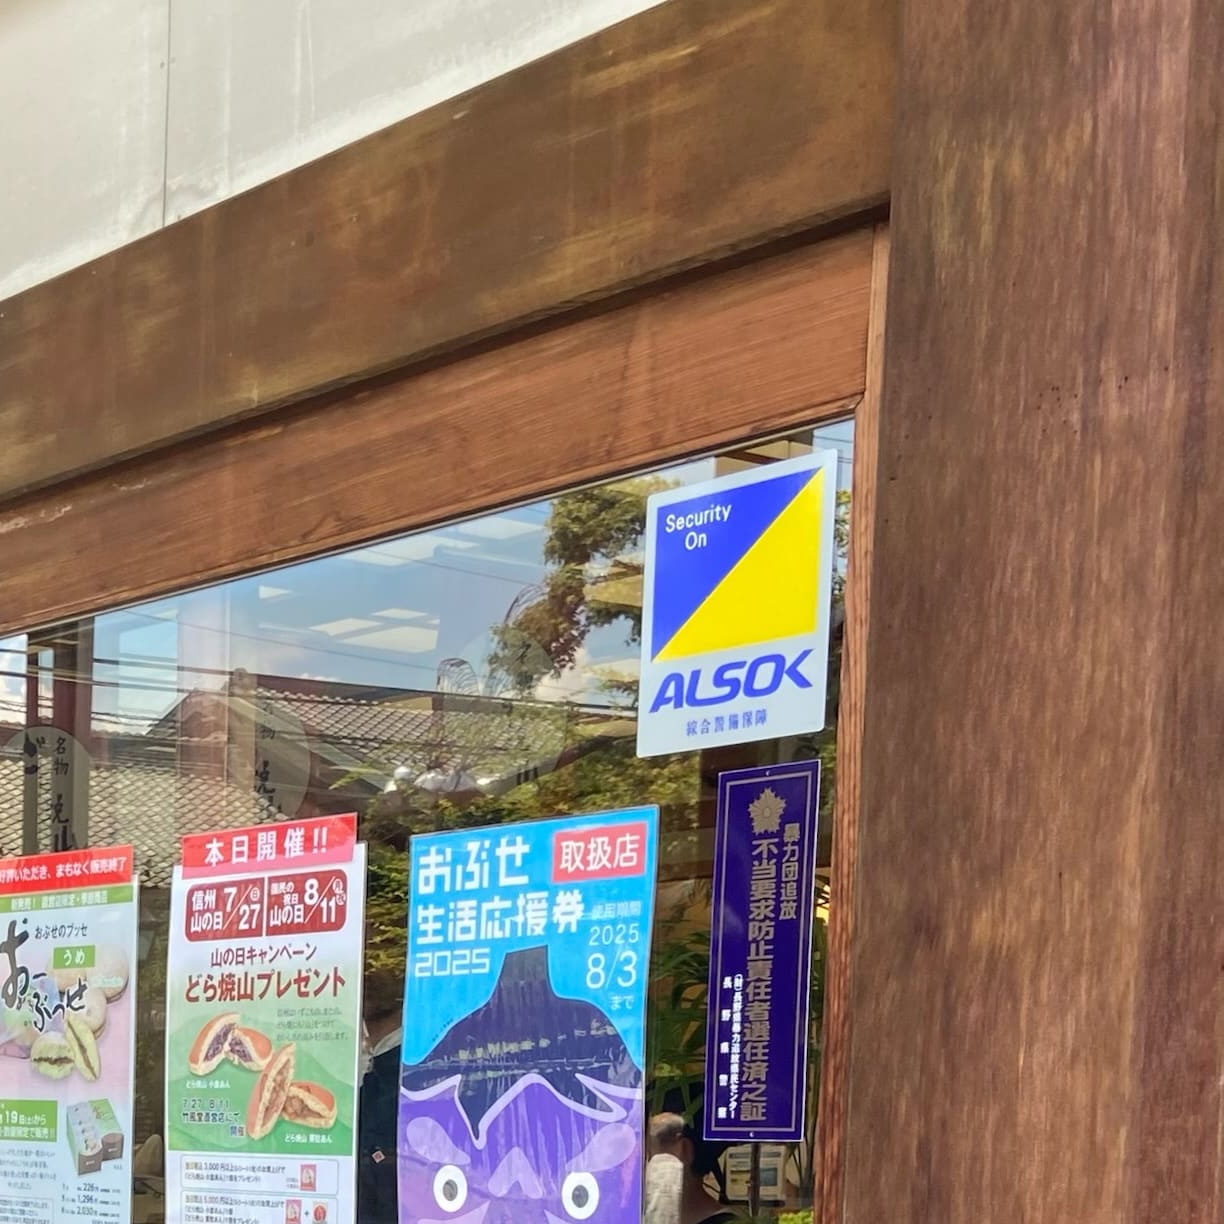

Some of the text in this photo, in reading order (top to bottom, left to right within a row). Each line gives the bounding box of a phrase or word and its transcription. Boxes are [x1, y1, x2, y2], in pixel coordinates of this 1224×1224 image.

[665, 503, 732, 533] Security
[684, 531, 708, 551] On
[648, 648, 815, 714] ALSOK
[686, 708, 768, 738] 綜合警備保障
[417, 838, 530, 894] おぶせ
[559, 833, 641, 873] 取扱店
[779, 822, 800, 920] 暴力団追放
[191, 888, 216, 911] 信州
[190, 910, 224, 934] 山の日
[269, 903, 305, 928] 山の日
[415, 888, 585, 945] 生活応援券
[589, 922, 641, 947] 2025
[63, 950, 86, 967] うめ
[210, 942, 317, 968] 山の日キャンペーン
[414, 947, 491, 978] 2025
[585, 949, 638, 990] 8/3
[185, 966, 346, 1003] どら焼山プレゼント
[610, 994, 634, 1011] まで
